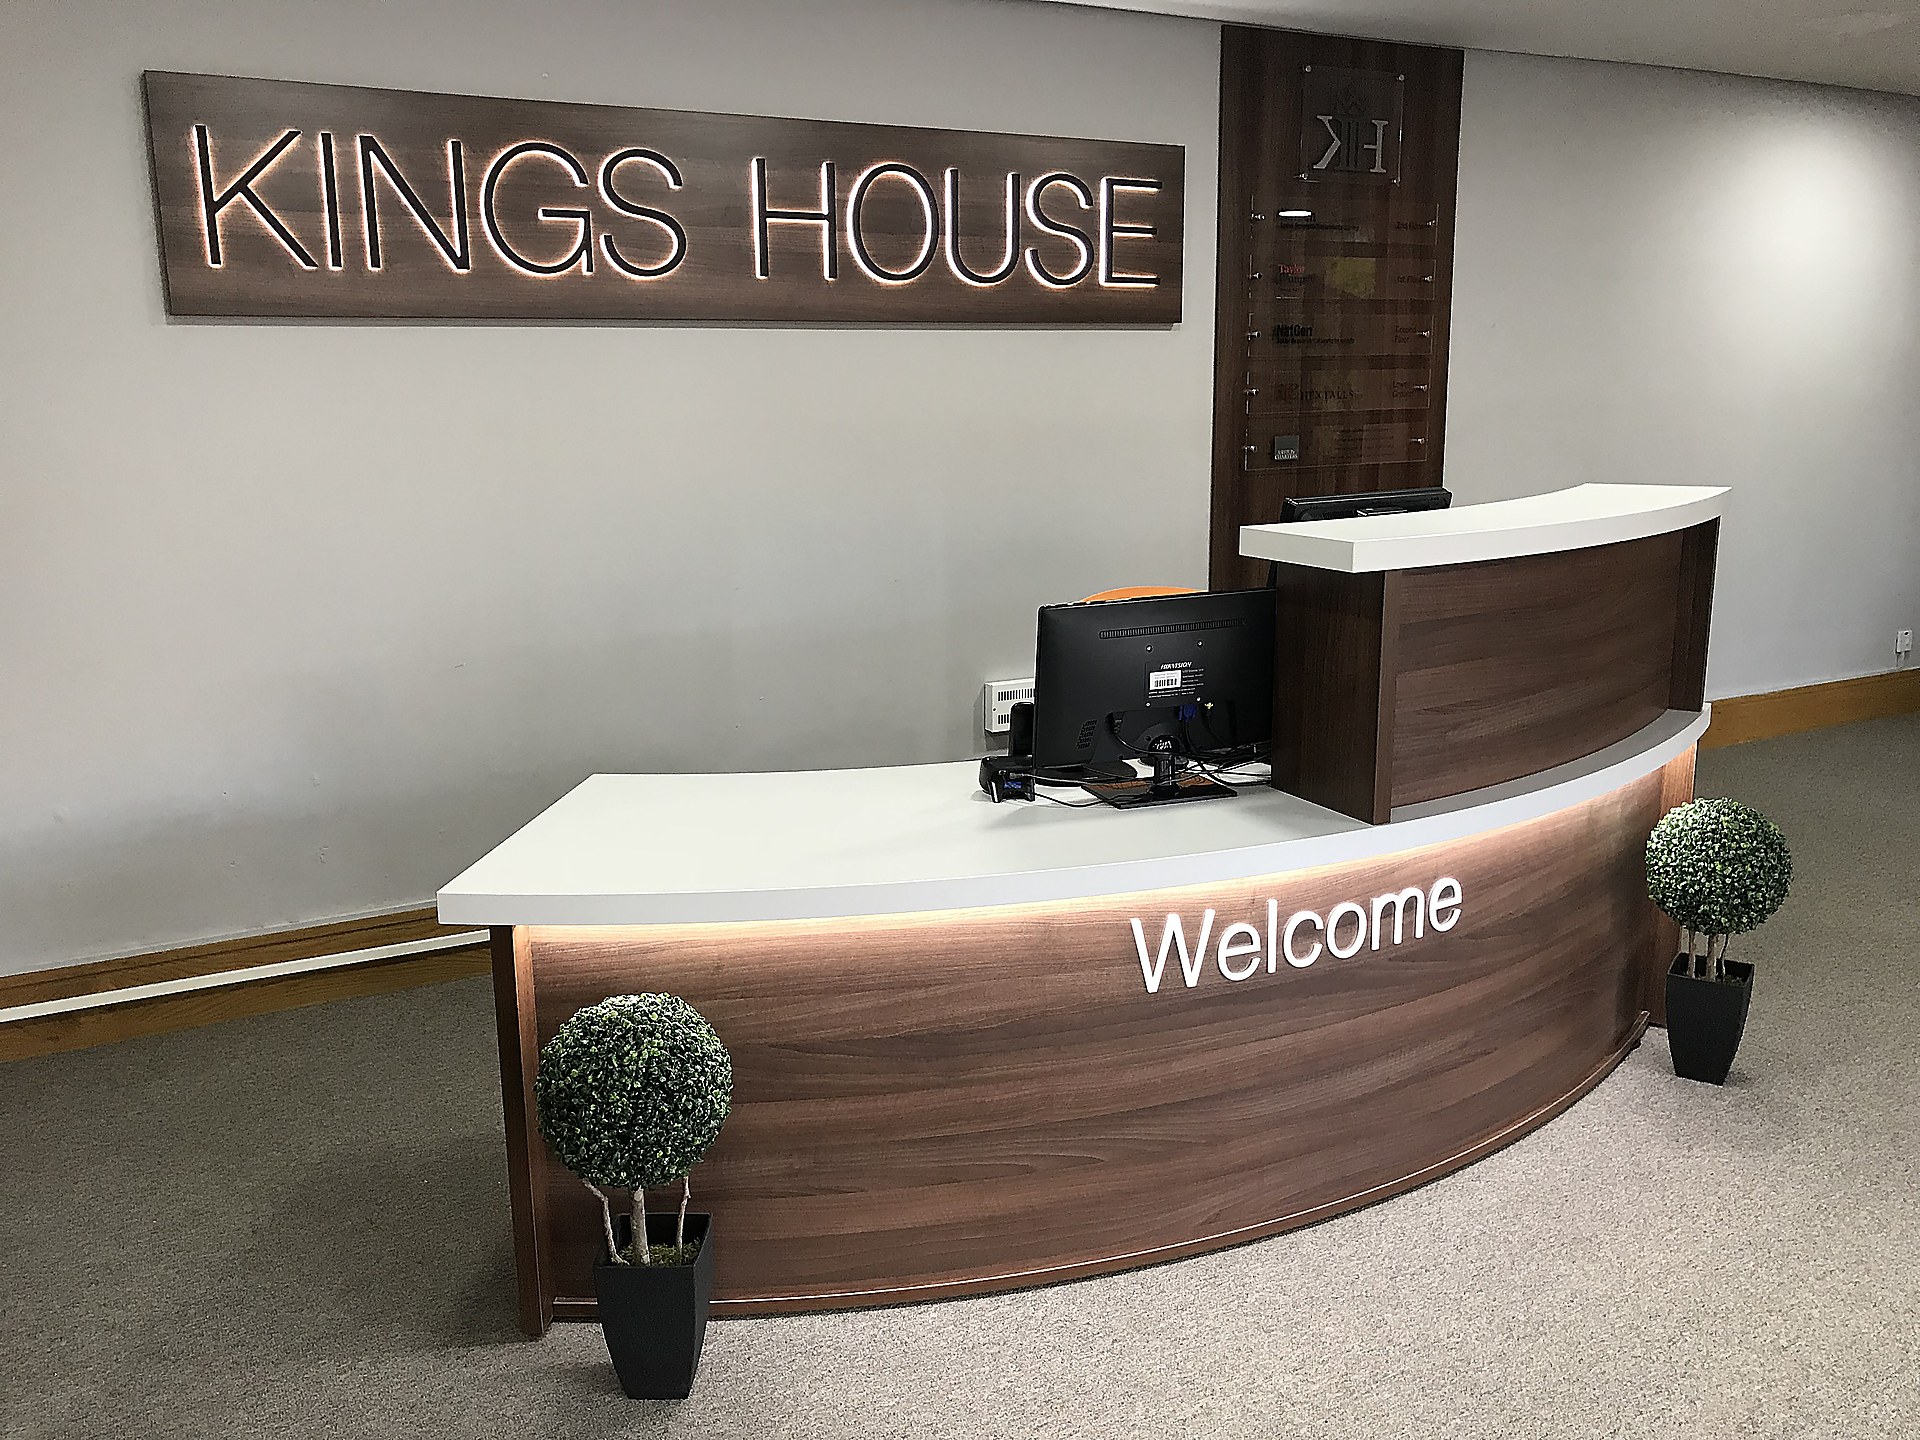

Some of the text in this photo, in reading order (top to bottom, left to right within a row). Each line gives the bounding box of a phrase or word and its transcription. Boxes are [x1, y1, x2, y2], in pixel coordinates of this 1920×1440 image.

[192, 123, 1164, 288] KINGS HOUSE
[1130, 876, 1464, 995] Welcome
